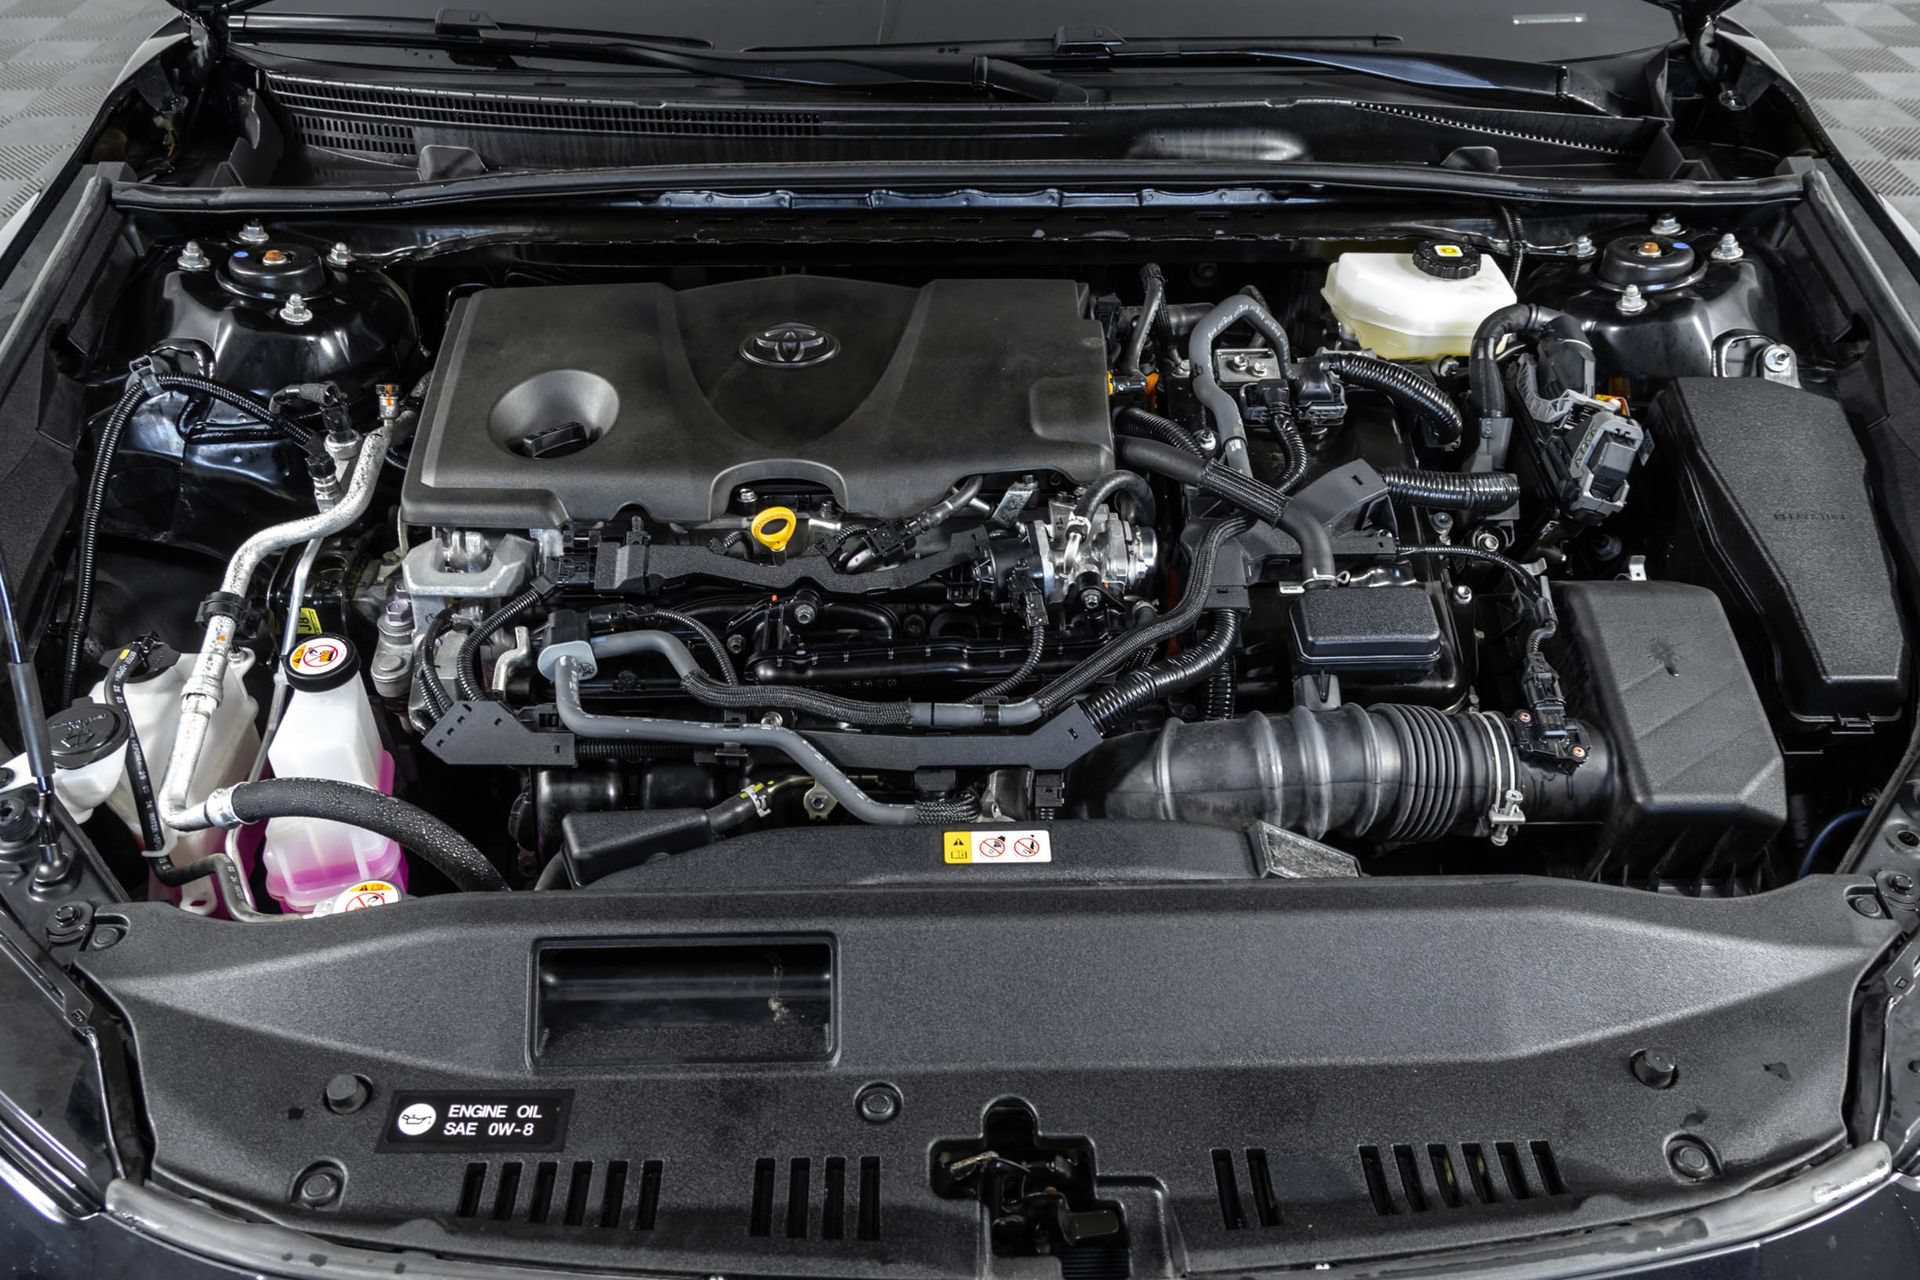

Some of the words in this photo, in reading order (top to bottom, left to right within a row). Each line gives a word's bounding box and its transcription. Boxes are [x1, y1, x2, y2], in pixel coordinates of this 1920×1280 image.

[448, 1104, 508, 1119] ENGINE
[516, 1104, 543, 1119] OIL
[443, 1122, 478, 1136] SAE
[488, 1122, 534, 1136] 0W-8
